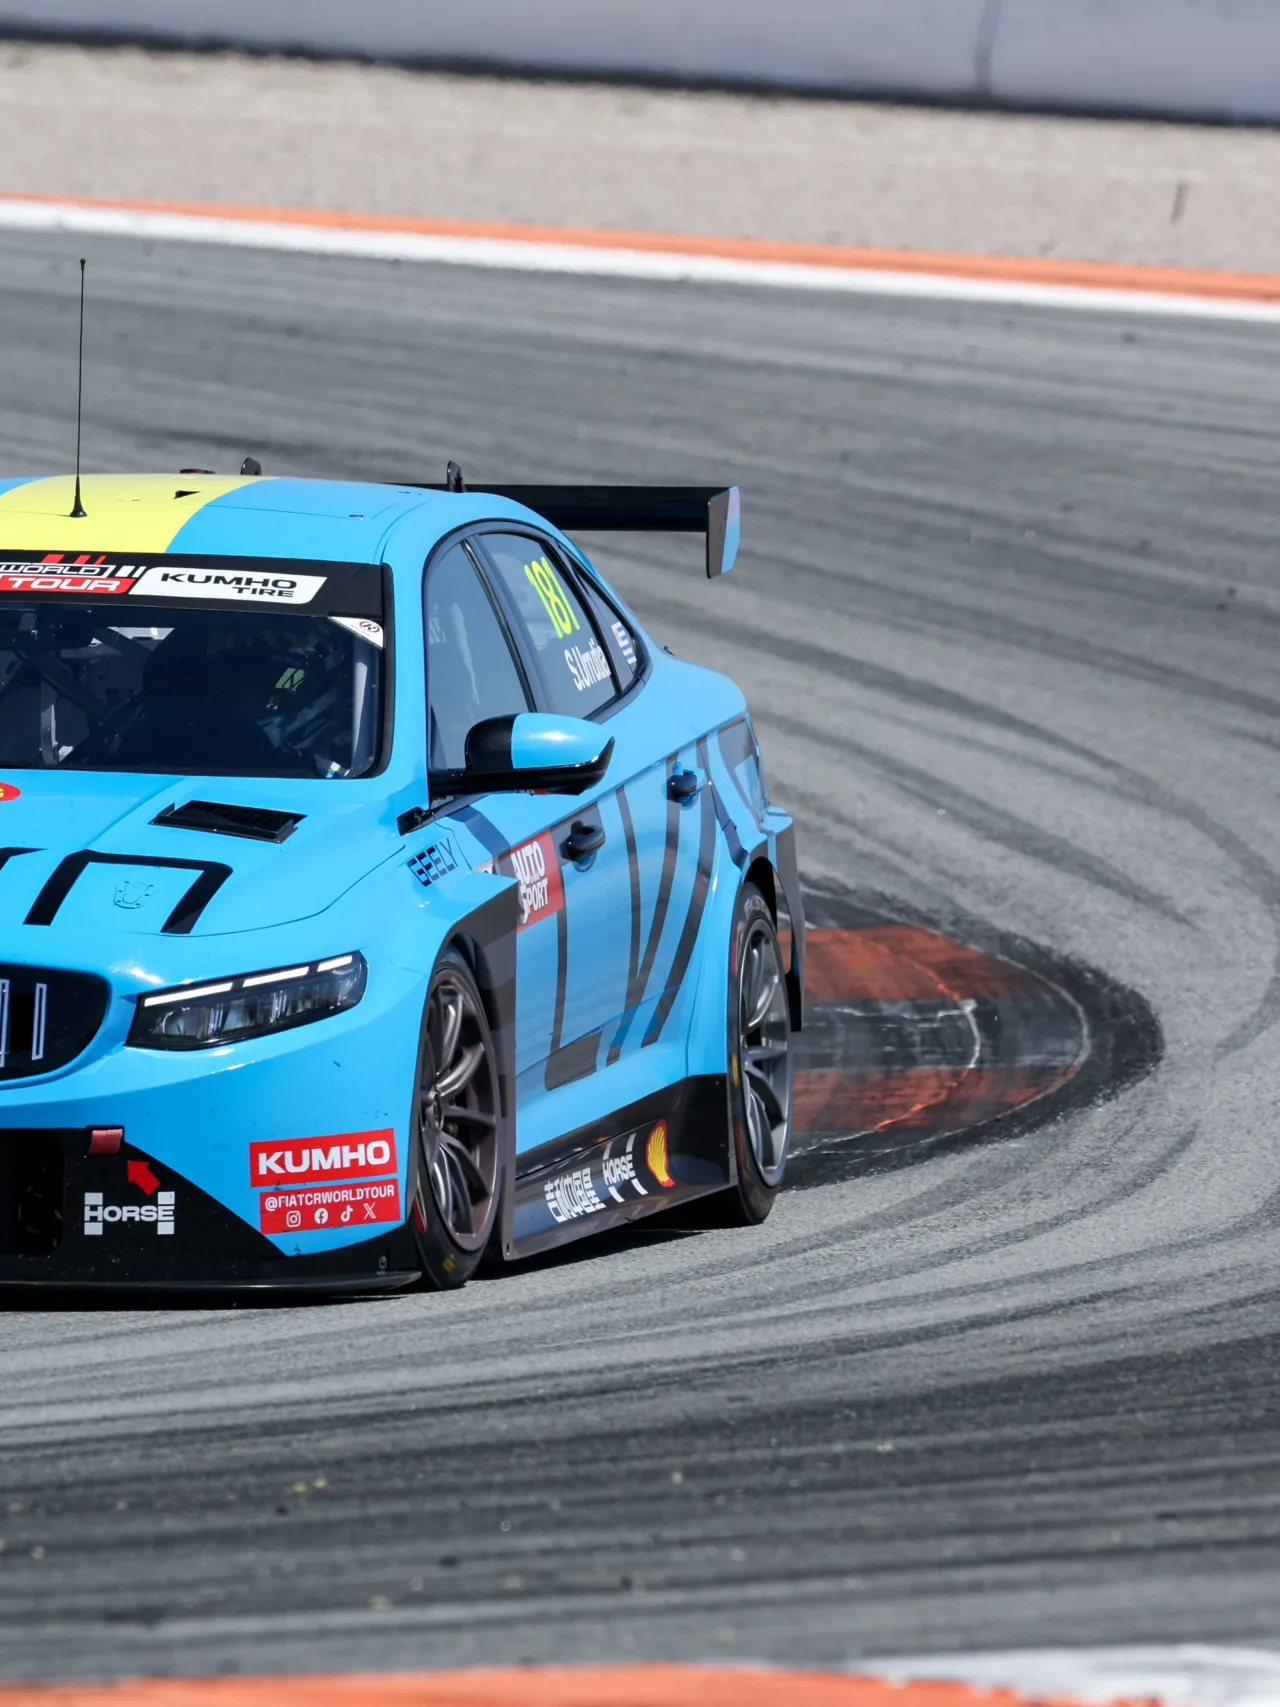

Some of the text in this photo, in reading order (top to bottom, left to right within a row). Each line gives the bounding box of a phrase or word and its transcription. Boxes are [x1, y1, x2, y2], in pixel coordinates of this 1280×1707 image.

[6, 577, 121, 592] TOUR
[160, 572, 298, 589] KUMHO
[232, 586, 294, 598] TIRE
[524, 557, 580, 639] 181
[406, 837, 458, 887] GEELY
[511, 841, 545, 885] AUTO
[518, 877, 549, 925] SPORT
[258, 1140, 391, 1175] KUMHO
[602, 1153, 636, 1186] HORSE
[265, 1184, 395, 1212] @FIATCRWORLDTOUR
